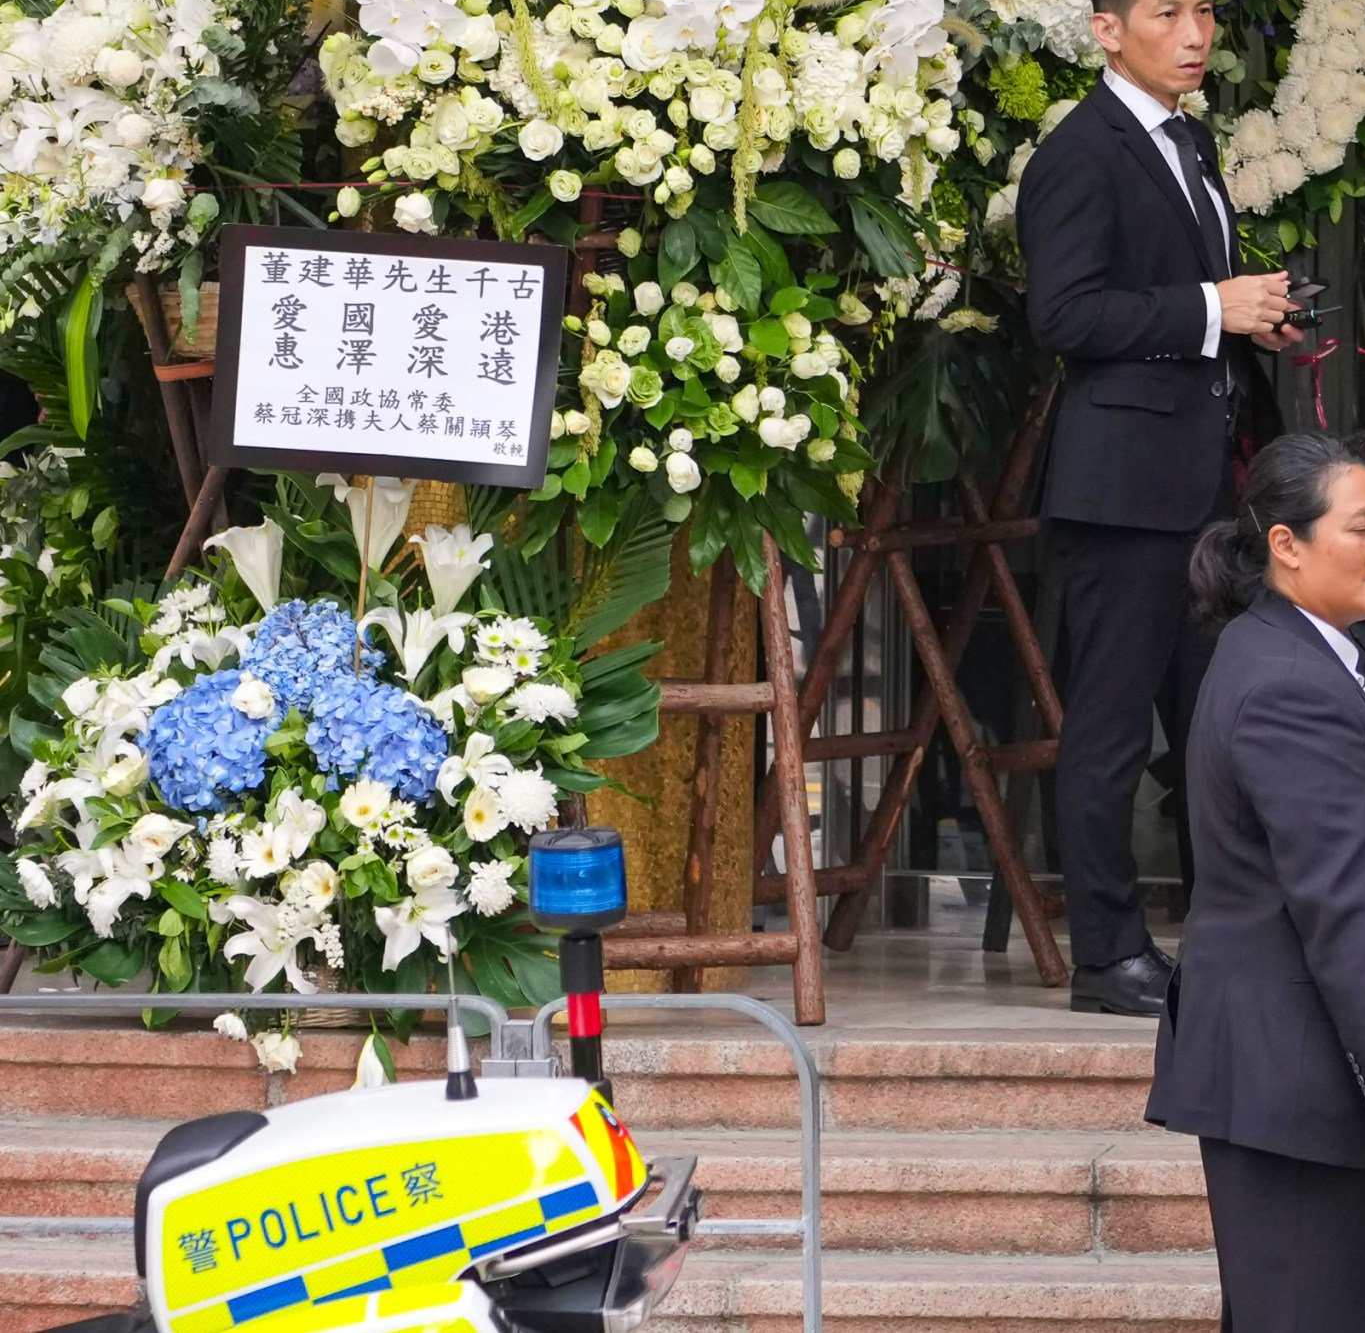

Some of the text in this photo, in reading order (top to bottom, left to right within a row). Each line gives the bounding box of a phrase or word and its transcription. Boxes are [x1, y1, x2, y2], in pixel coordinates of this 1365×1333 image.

[261, 251, 541, 301] 董建華先生千古
[270, 293, 521, 346] 愛國愛港
[268, 332, 518, 386] 惠澤深遠
[296, 384, 456, 414] 全國政協常委
[493, 442, 525, 458] 敬輓
[177, 1160, 444, 1275] 警 POLICE 察
